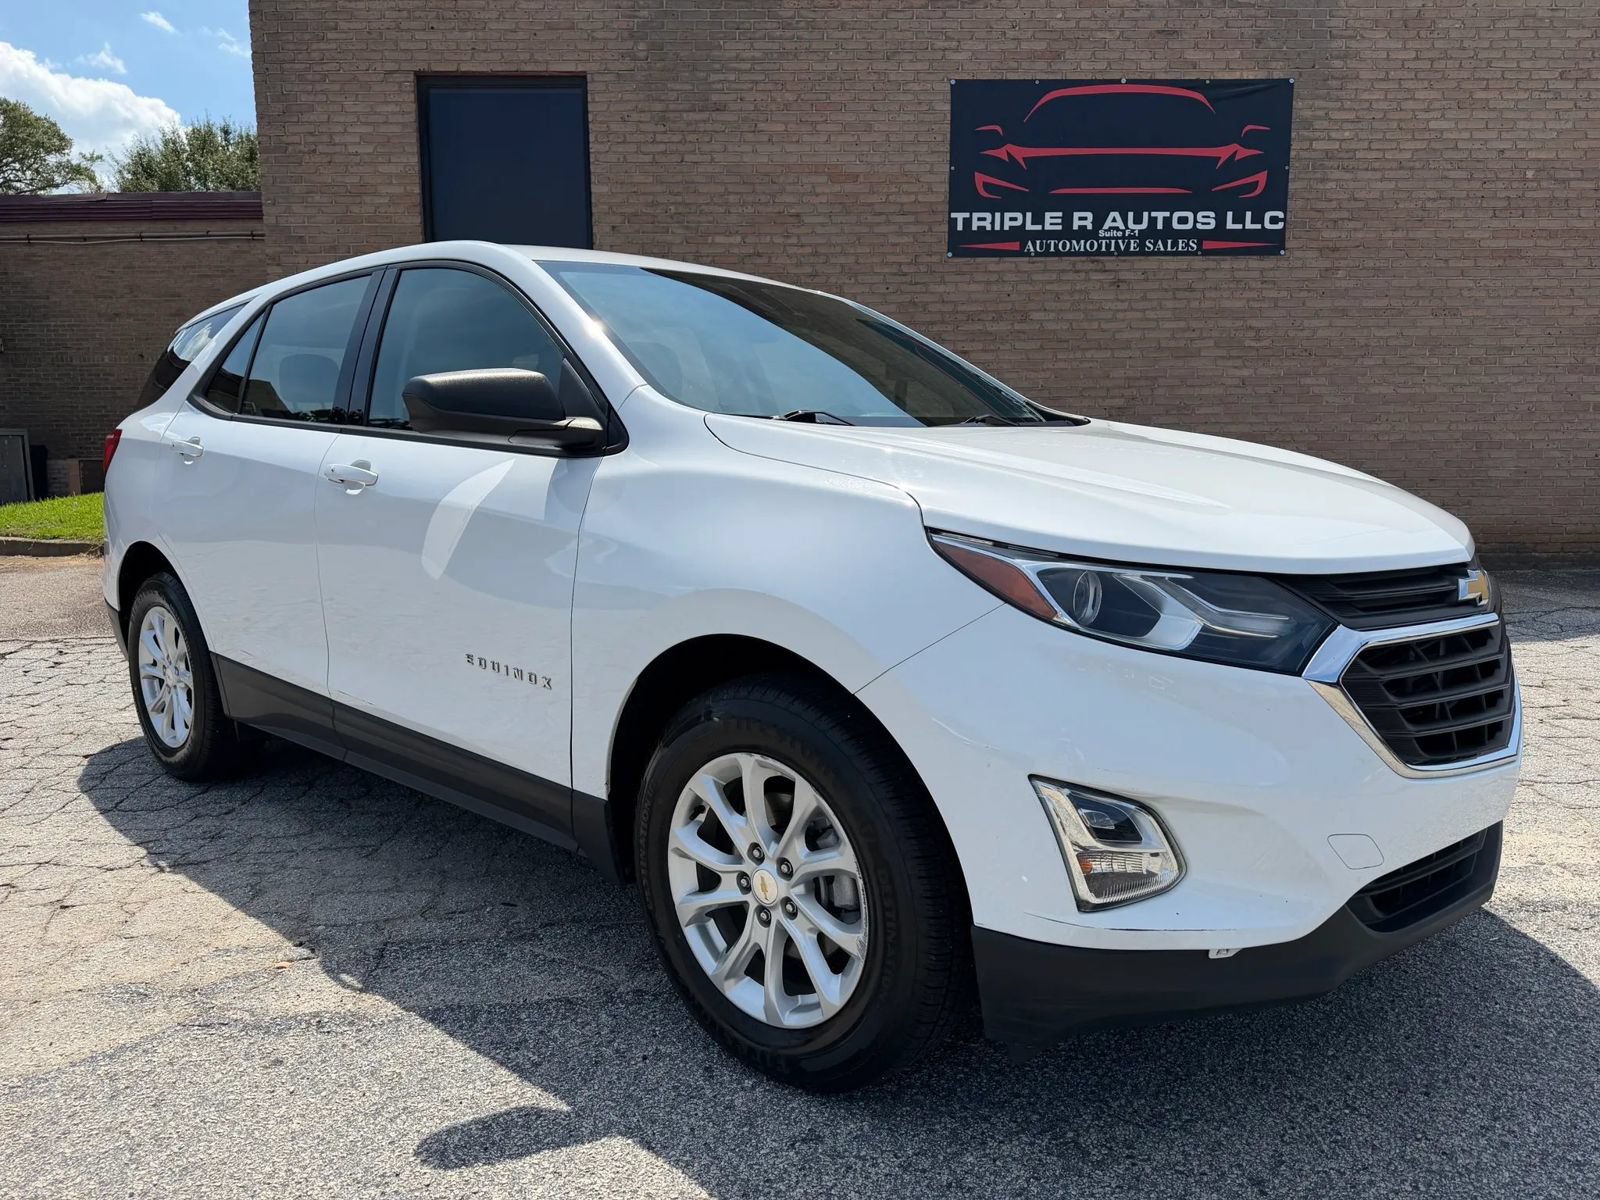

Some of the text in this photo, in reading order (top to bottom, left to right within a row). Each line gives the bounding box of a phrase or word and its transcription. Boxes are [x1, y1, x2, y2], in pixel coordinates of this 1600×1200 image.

[950, 211, 1285, 231] TRIPLE R AUTOS LLC
[1098, 229, 1139, 237] Suite F-1
[1024, 239, 1198, 253] AUTOMOTIVE SALES
[465, 653, 552, 690] EQUINOX
